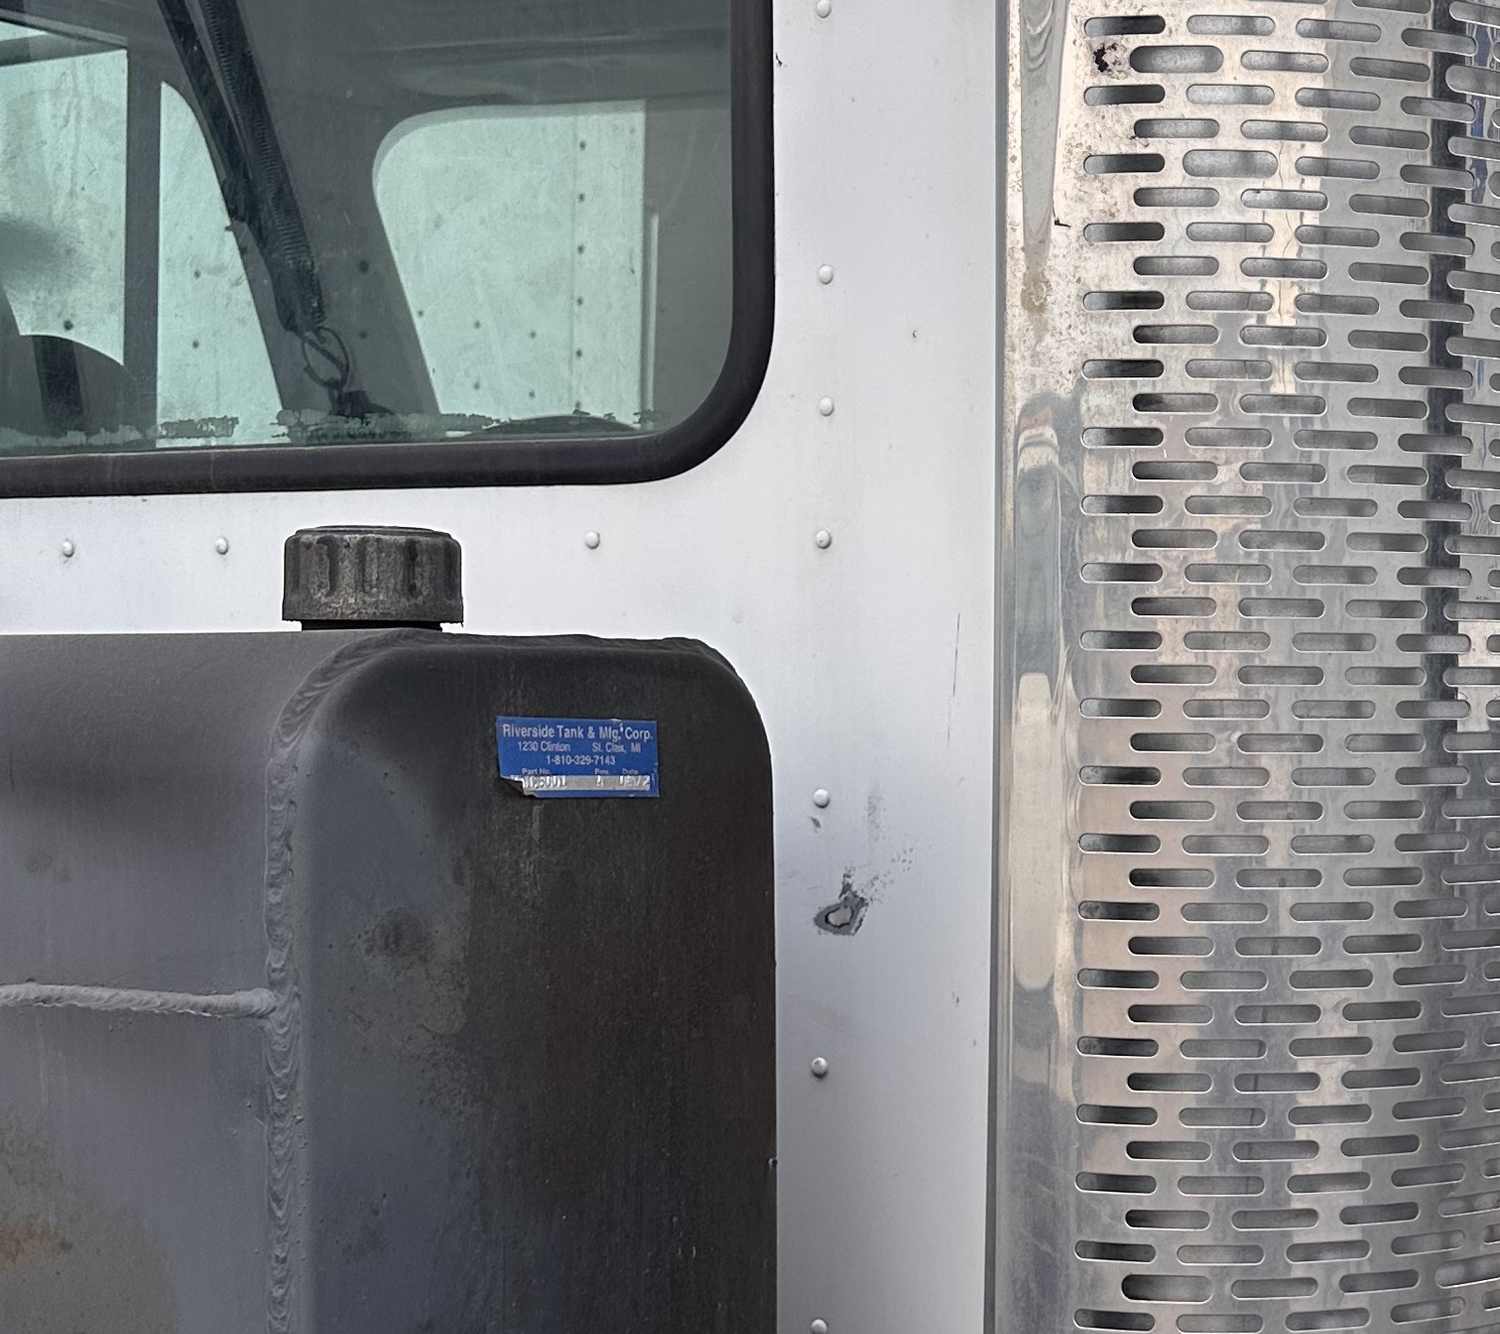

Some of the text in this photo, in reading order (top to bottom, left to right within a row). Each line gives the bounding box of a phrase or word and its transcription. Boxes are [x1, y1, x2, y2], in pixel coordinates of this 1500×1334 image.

[503, 723, 555, 738] Riverside
[557, 724, 584, 739] Tank
[588, 726, 595, 739] &
[625, 726, 653, 743] Corp.
[517, 740, 571, 752] 1230 Clinton
[546, 754, 616, 765] 1-810-329-7143
